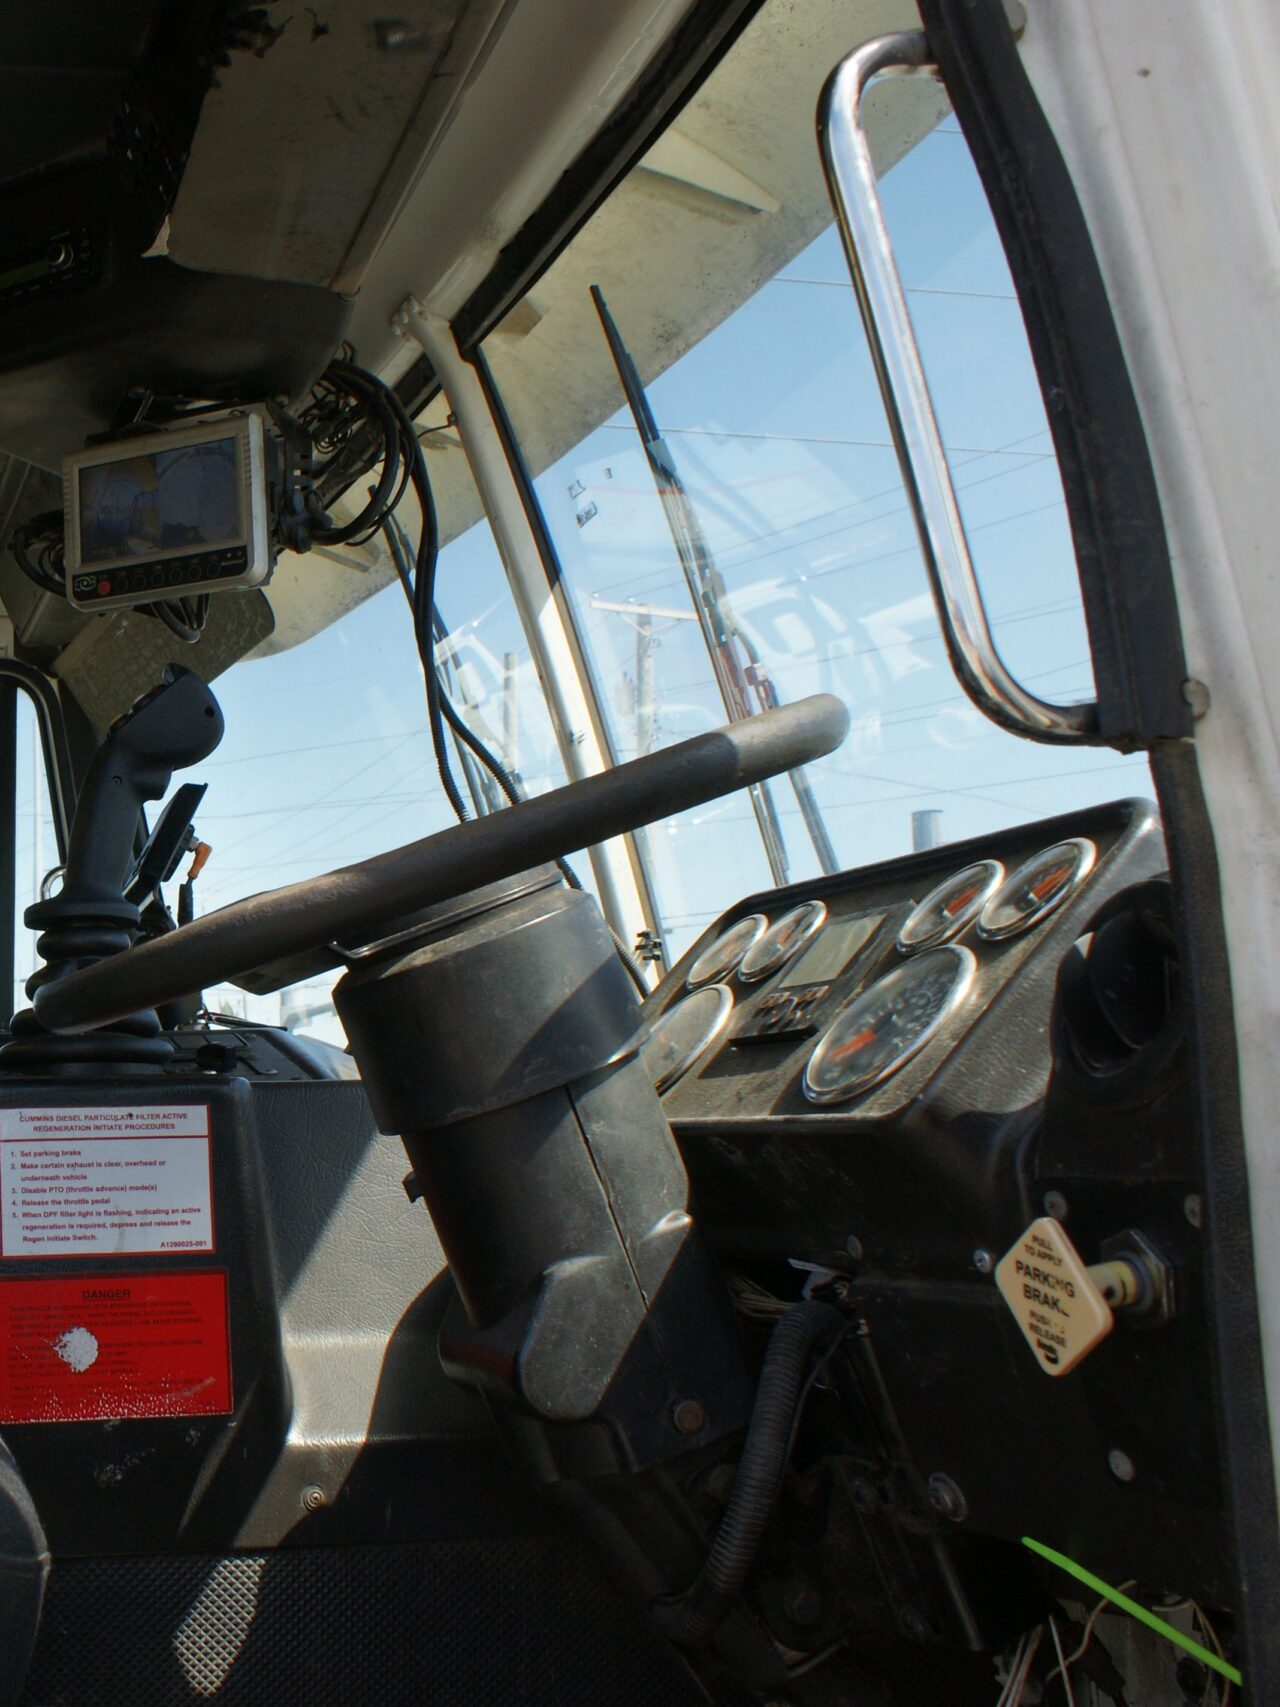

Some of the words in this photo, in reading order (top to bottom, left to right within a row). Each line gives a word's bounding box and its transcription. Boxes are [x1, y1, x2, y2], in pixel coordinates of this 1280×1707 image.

[22, 1223, 66, 1231] regeneration
[1031, 1234, 1054, 1251] PULL
[1024, 1243, 1036, 1256] TO
[1037, 1249, 1063, 1267] APPLY
[81, 1289, 131, 1299] DANGER
[1028, 1323, 1066, 1347] RELEASE
